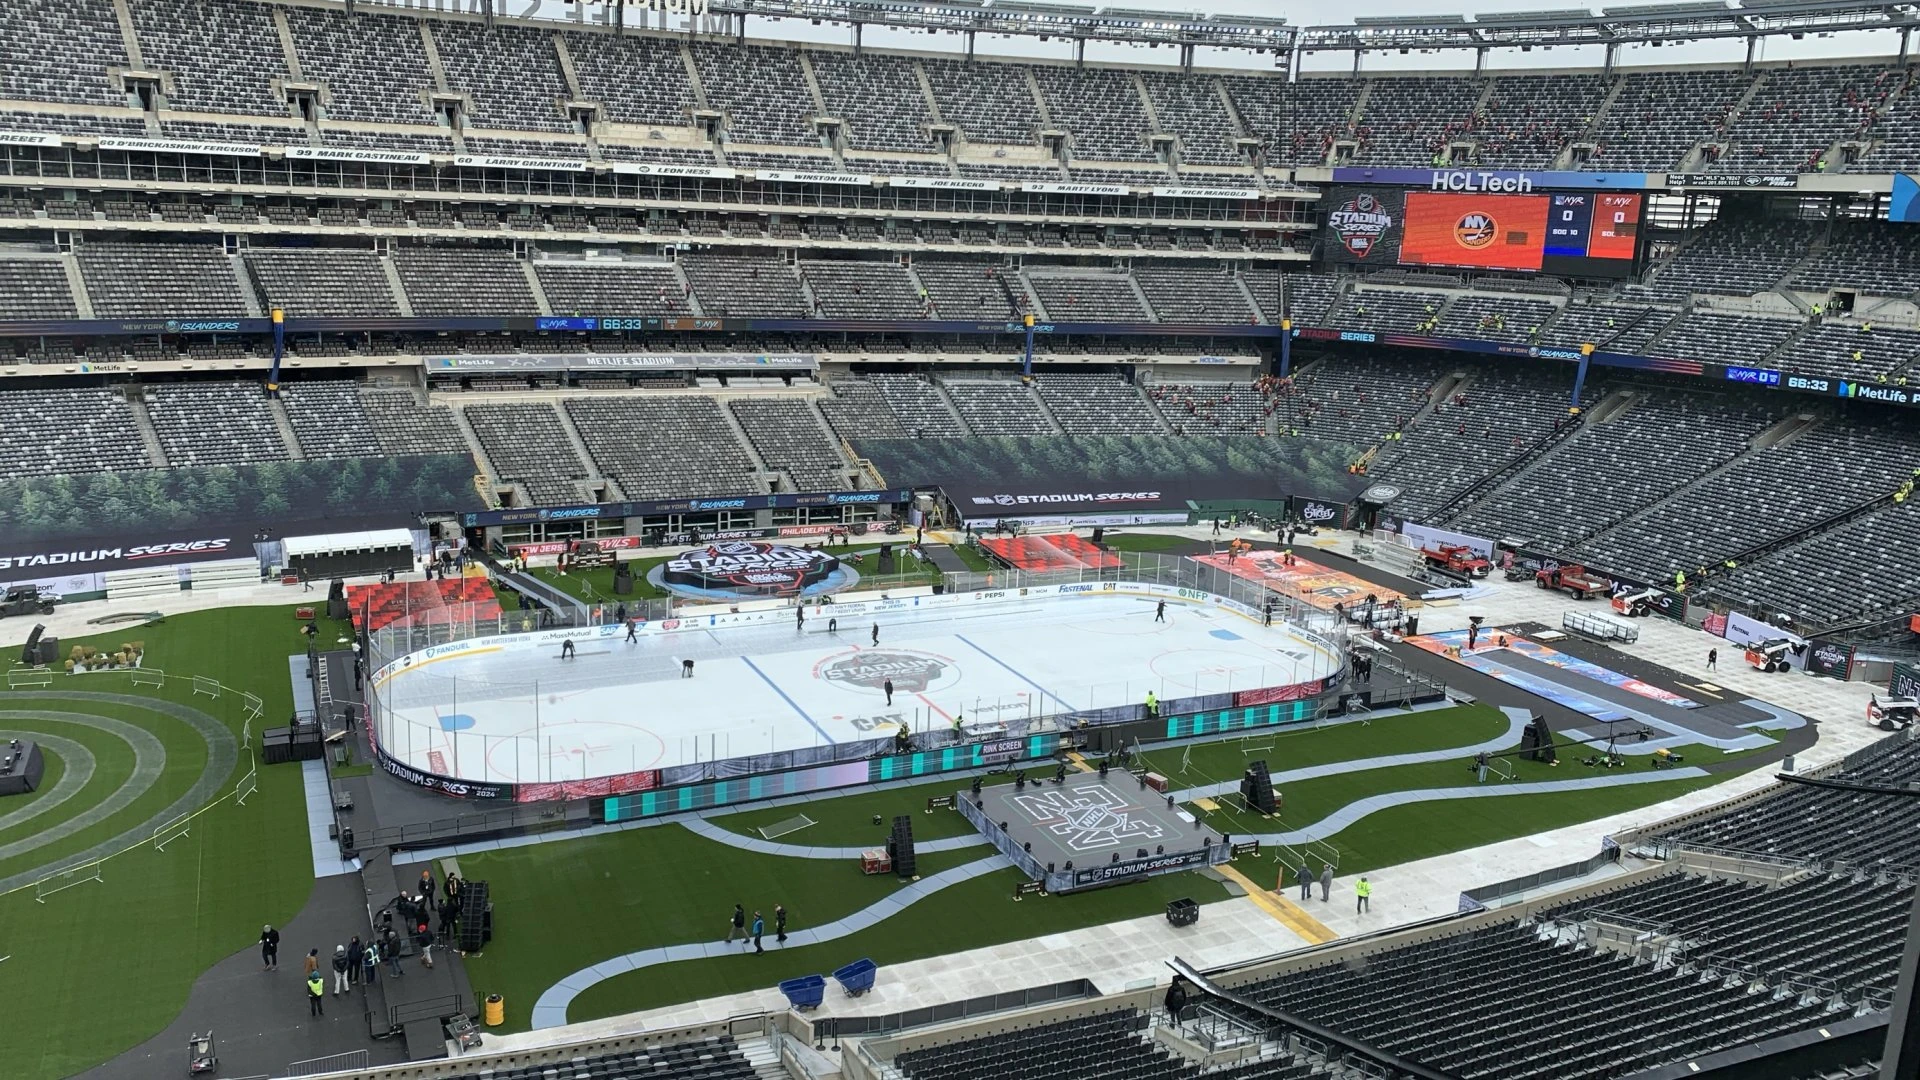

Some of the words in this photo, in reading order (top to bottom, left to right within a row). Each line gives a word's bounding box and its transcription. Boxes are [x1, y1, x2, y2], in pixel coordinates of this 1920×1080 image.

[203, 144, 260, 154] FERGUSON
[296, 149, 313, 157] 99
[316, 150, 354, 158] MARK
[355, 152, 420, 162] GASTINEAU
[485, 158, 521, 166] LARRY
[521, 160, 582, 169] GRANTHAM
[657, 167, 684, 175] LEON
[684, 168, 711, 176] HESS
[794, 174, 838, 182] WINSTON
[838, 175, 859, 183] HILL
[1431, 171, 1532, 193] HCLTech
[1057, 184, 1089, 192] MARTY
[1181, 188, 1204, 196] NICK
[1204, 190, 1248, 198] MANGOLD
[1564, 196, 1585, 206] NYR
[1329, 211, 1392, 228] STADIUM
[1562, 209, 1574, 221] 0
[1613, 211, 1625, 223] 0
[1338, 223, 1384, 232] SERIES
[142, 322, 164, 330] YORK
[179, 321, 240, 332] ISLANDERS
[549, 320, 569, 328] NYR
[602, 318, 642, 330] 66:33
[458, 358, 495, 367] MetLife
[586, 357, 630, 366] METLIFE
[632, 356, 675, 366] STADIUM
[771, 356, 803, 364] MetLife
[93, 364, 121, 372] MetLife
[1736, 369, 1758, 382] NYR
[1787, 377, 1830, 392] 66:33
[1858, 385, 1908, 403] MetLife
[797, 496, 810, 504] NEW
[836, 493, 881, 503] ISLANDERS
[1016, 493, 1094, 505] STADIUM
[1093, 491, 1162, 502] SERIES
[699, 499, 746, 510] ISLANDERS
[518, 512, 537, 520] YORK
[549, 508, 601, 520] ISLANDERS
[0, 547, 123, 570] STADIUM
[123, 538, 231, 557] SERIES
[667, 550, 836, 572] STADIUM
[702, 560, 812, 574] SERIES
[772, 564, 811, 572] JERSEY
[1057, 584, 1095, 594] FASTENAL
[1103, 582, 1117, 591] CAT
[1187, 589, 1209, 601] NFP
[549, 629, 592, 641] MassMutual
[600, 625, 616, 636] SAP
[436, 642, 470, 656] FANDUEL
[1814, 648, 1846, 664] STADIUM
[825, 658, 947, 681] STADIUM
[852, 666, 930, 681] SERIES
[967, 701, 1030, 714] verizon
[850, 713, 906, 732] CAT
[982, 744, 998, 754] RINK
[998, 740, 1023, 752] SCREEN
[387, 760, 425, 786] STADIUM
[475, 790, 496, 798] 2024
[1082, 809, 1106, 828] NHL
[1103, 861, 1148, 879] STADIUM
[1147, 855, 1186, 870] SERIES
